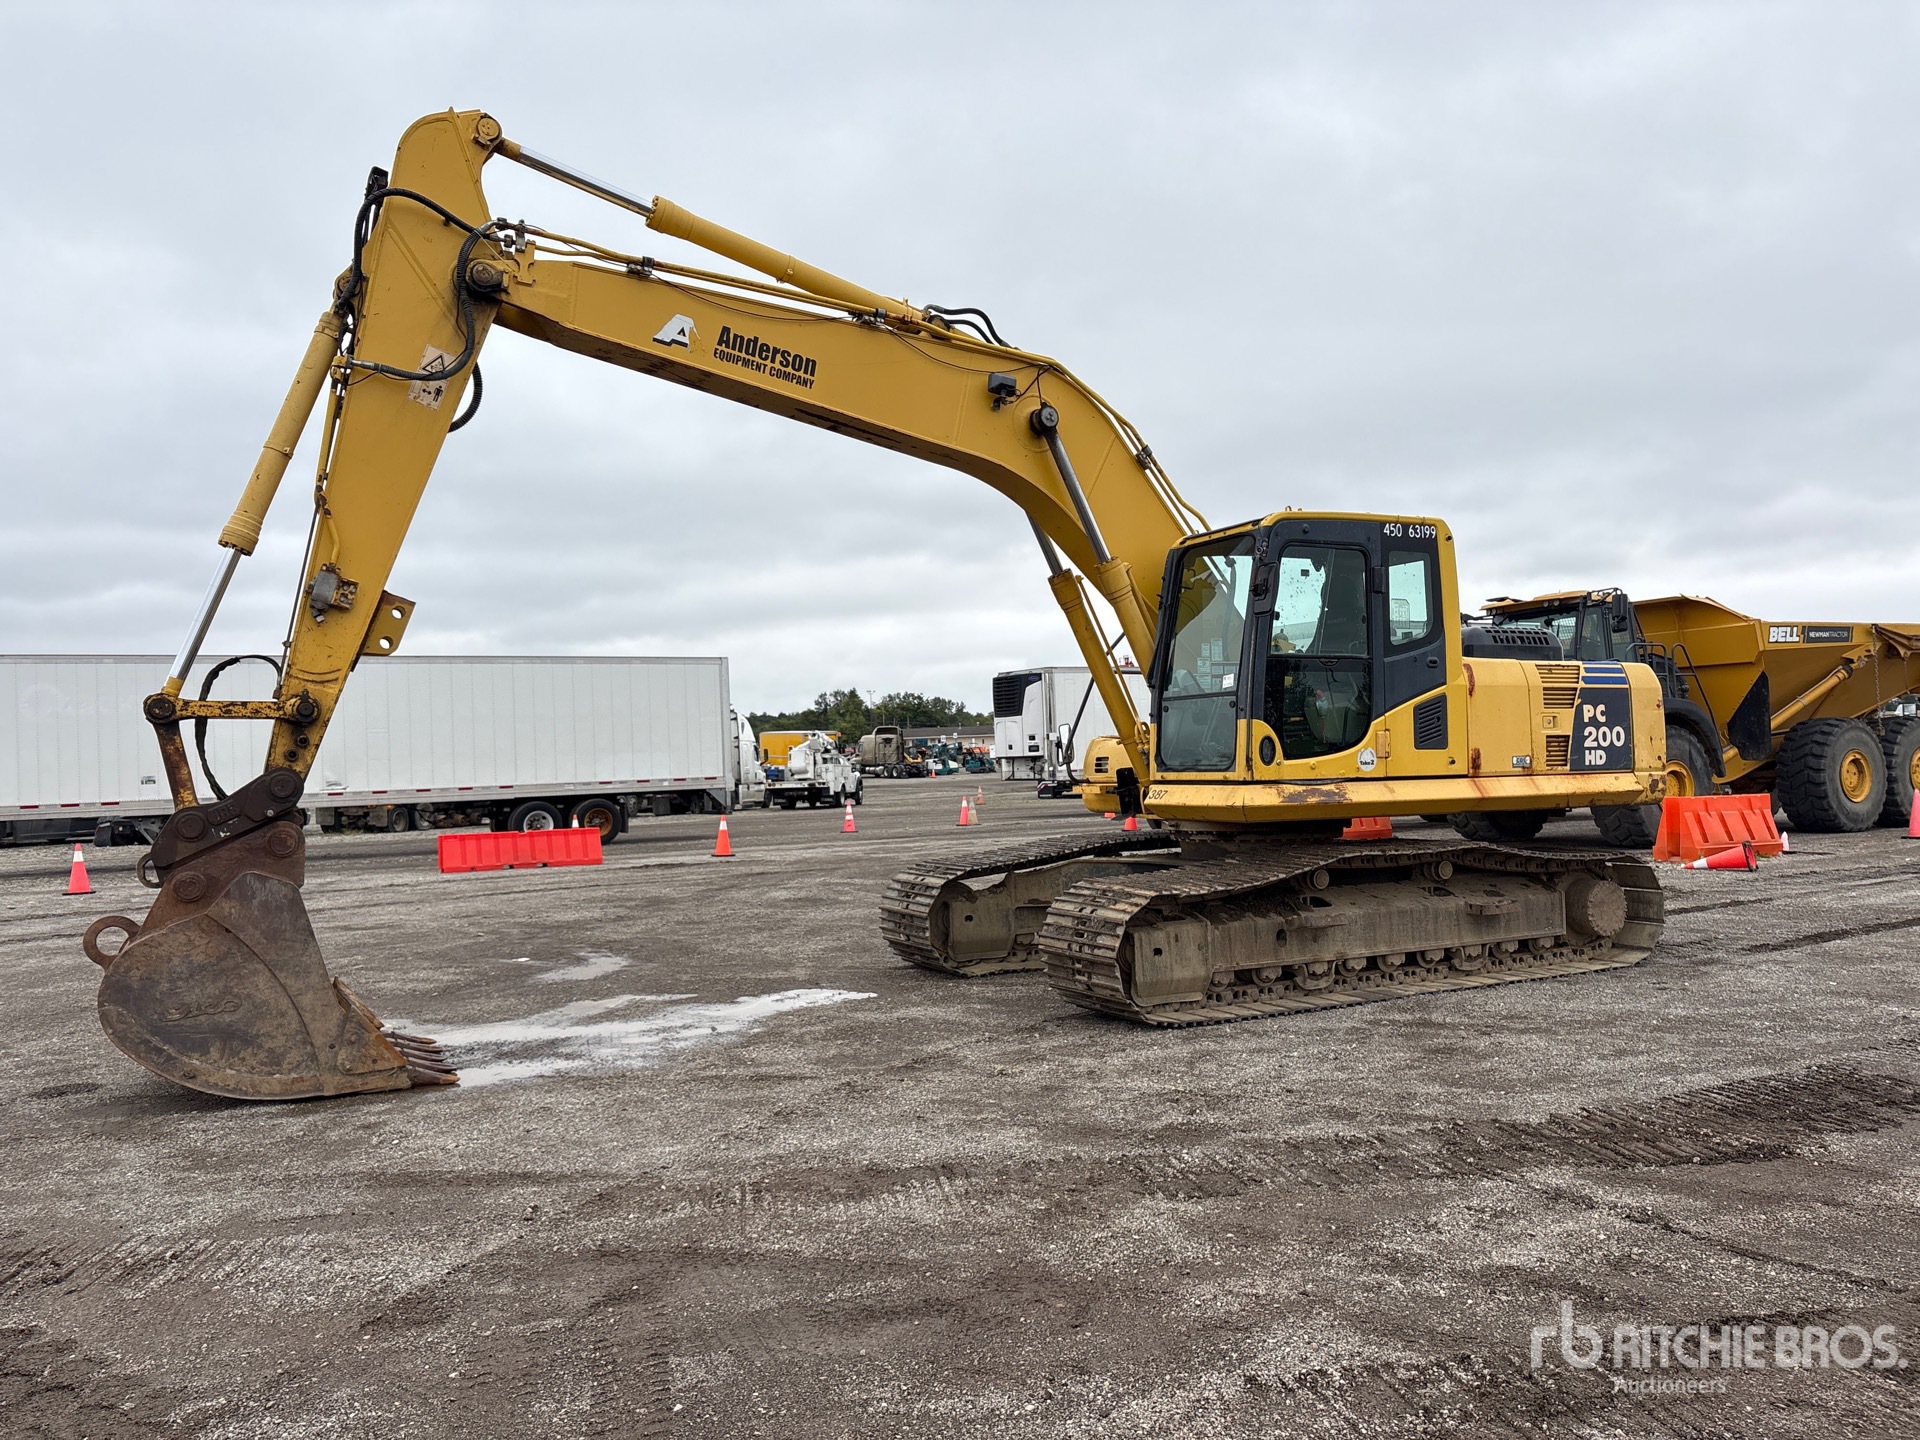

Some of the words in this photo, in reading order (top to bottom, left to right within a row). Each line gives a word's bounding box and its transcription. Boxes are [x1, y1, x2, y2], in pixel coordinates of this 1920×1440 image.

[717, 325, 817, 377] Anderson
[714, 348, 768, 375] EQUIPMENT
[769, 363, 815, 389] COMPANY
[1383, 523, 1403, 537] 450
[1408, 525, 1437, 539] 63199
[1769, 626, 1799, 643] BELL
[1583, 704, 1606, 723] PC
[1583, 726, 1625, 747] 200
[1585, 749, 1607, 765] HD
[1148, 789, 1168, 800] 387
